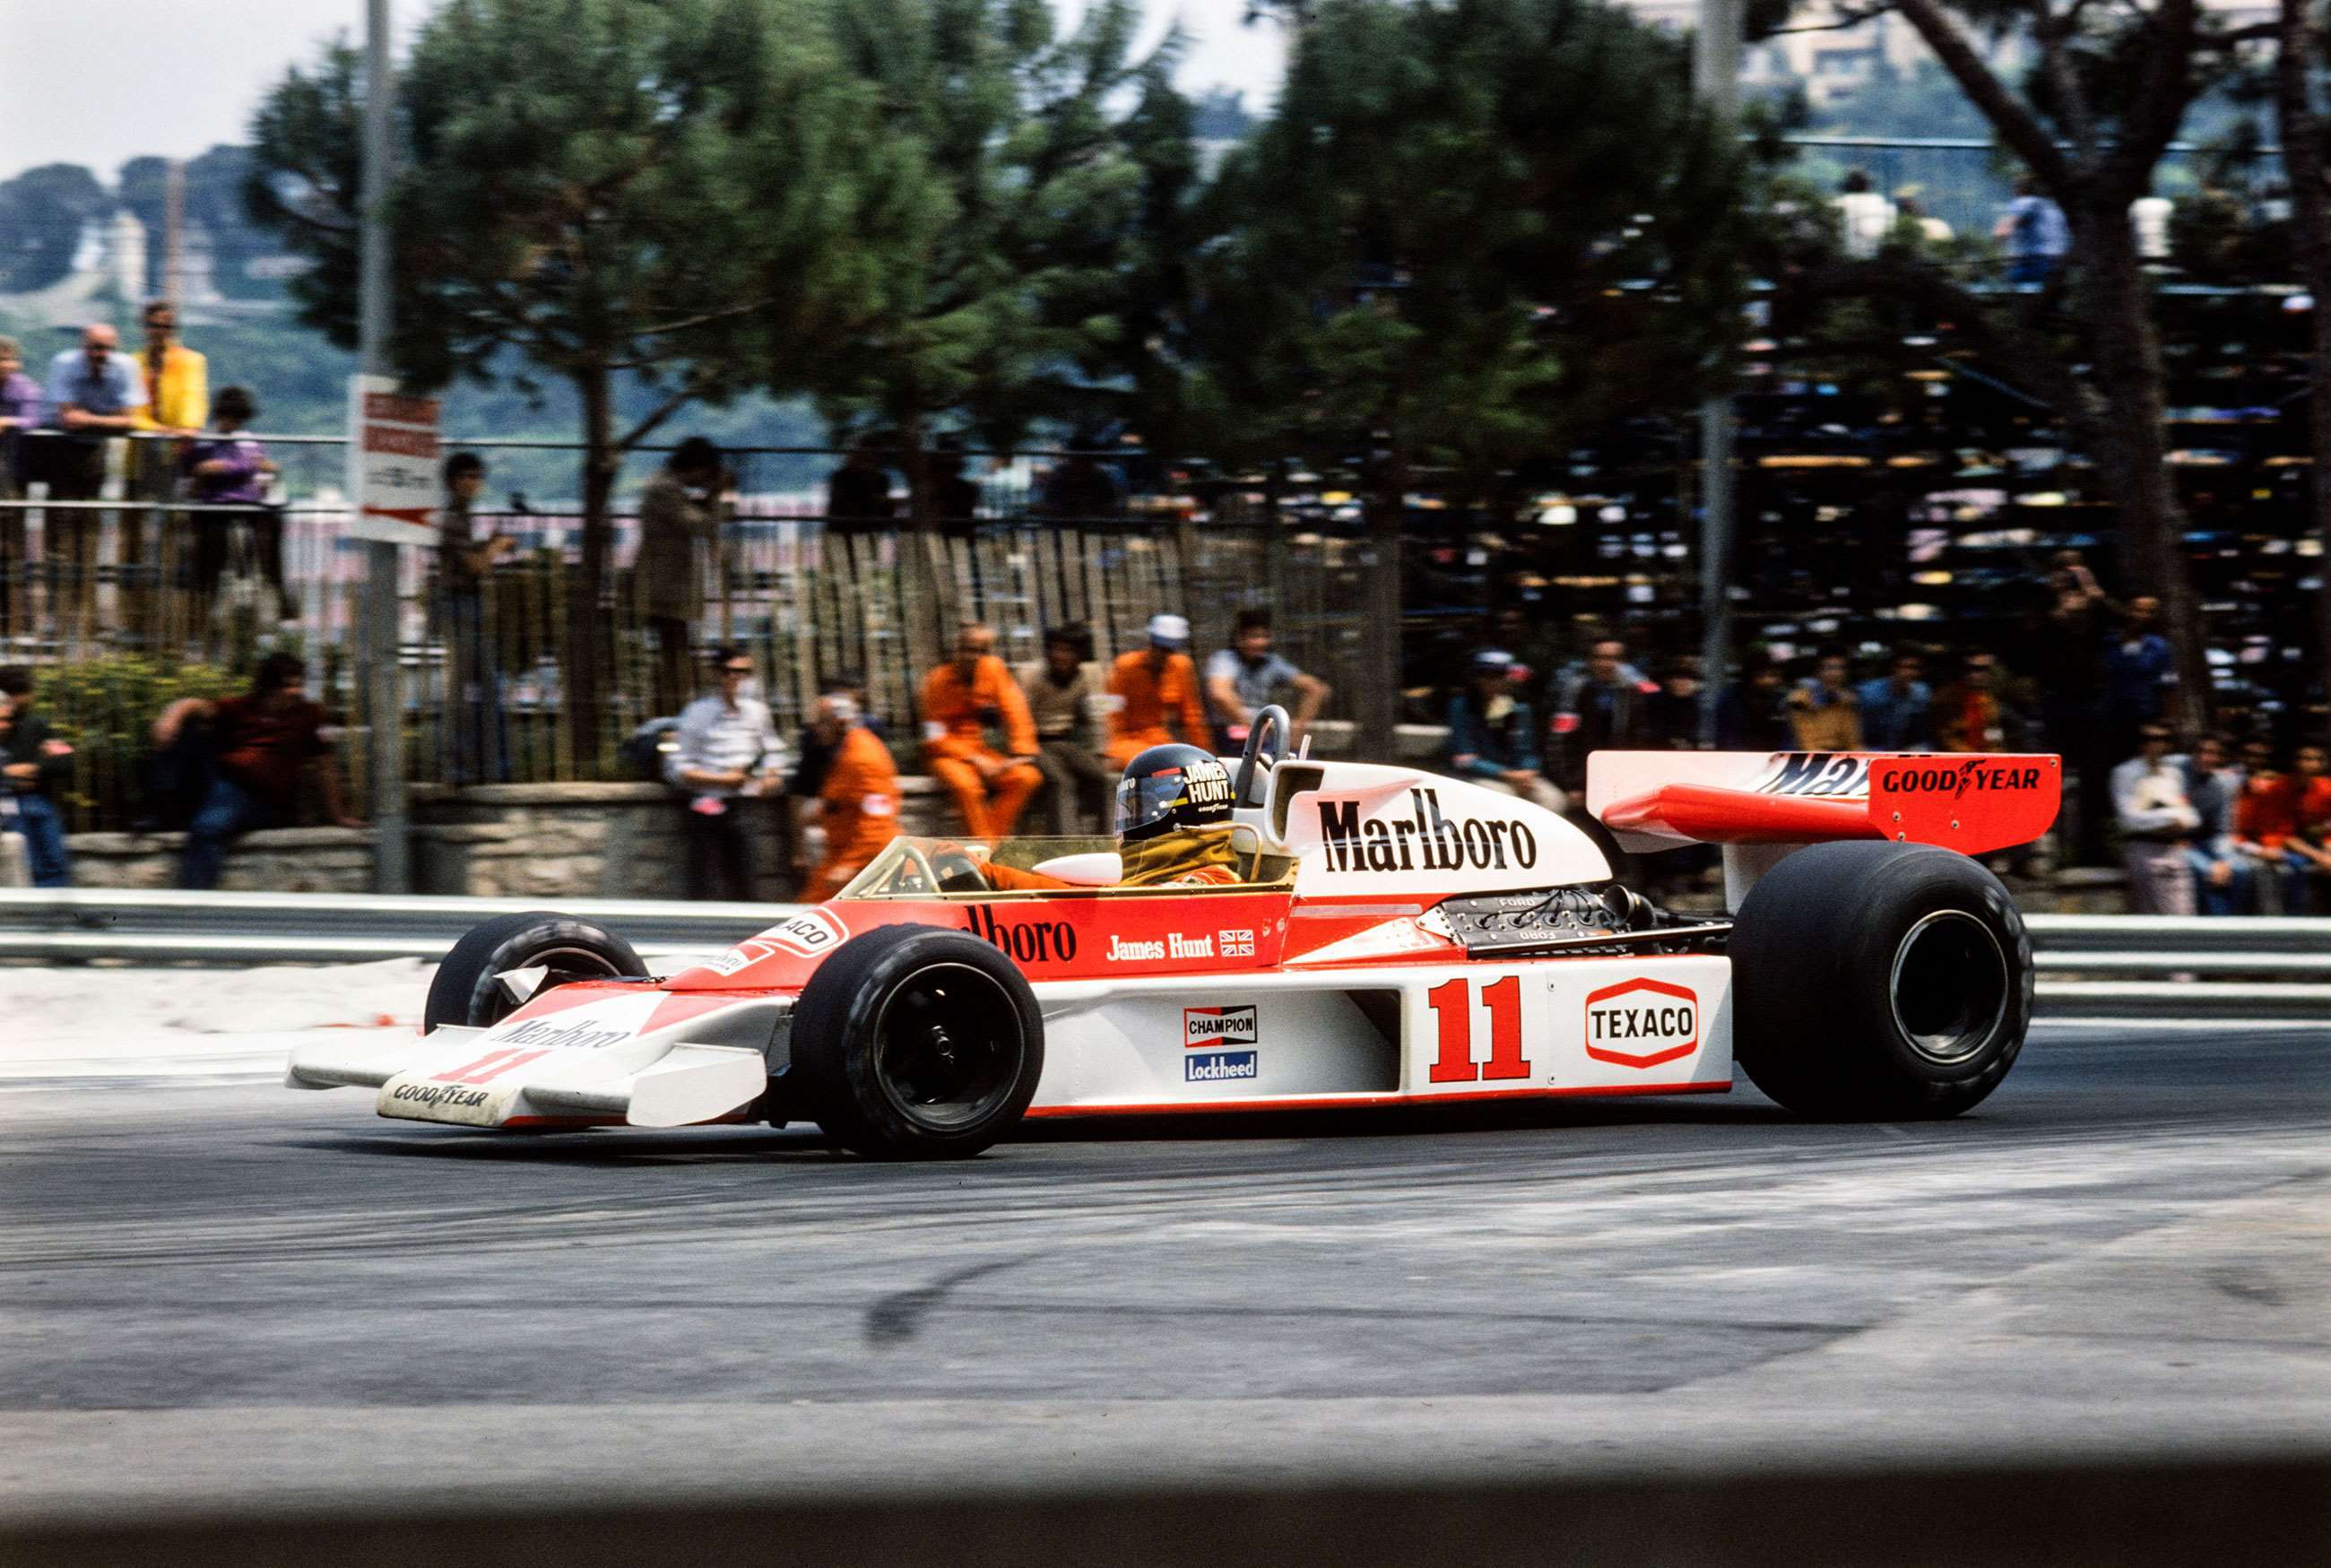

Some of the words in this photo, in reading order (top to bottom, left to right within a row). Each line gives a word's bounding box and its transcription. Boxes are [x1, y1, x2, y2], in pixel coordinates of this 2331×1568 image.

[1183, 761, 1227, 784] JAMES
[1188, 780, 1229, 803] HUNT
[1317, 788, 1537, 872] Marlboro
[1499, 898, 1536, 906] FORD
[784, 920, 829, 945] ACO
[961, 904, 1077, 962] lboro
[1106, 935, 1166, 961] James
[1167, 932, 1215, 959] Hunt
[490, 1020, 632, 1048] Marlboro
[1189, 1018, 1253, 1035] CHAMPION
[1428, 975, 1530, 1084] 11
[1590, 1007, 1694, 1039] TEXACO
[427, 1047, 554, 1085] 11
[1188, 1053, 1255, 1080] Lockheed
